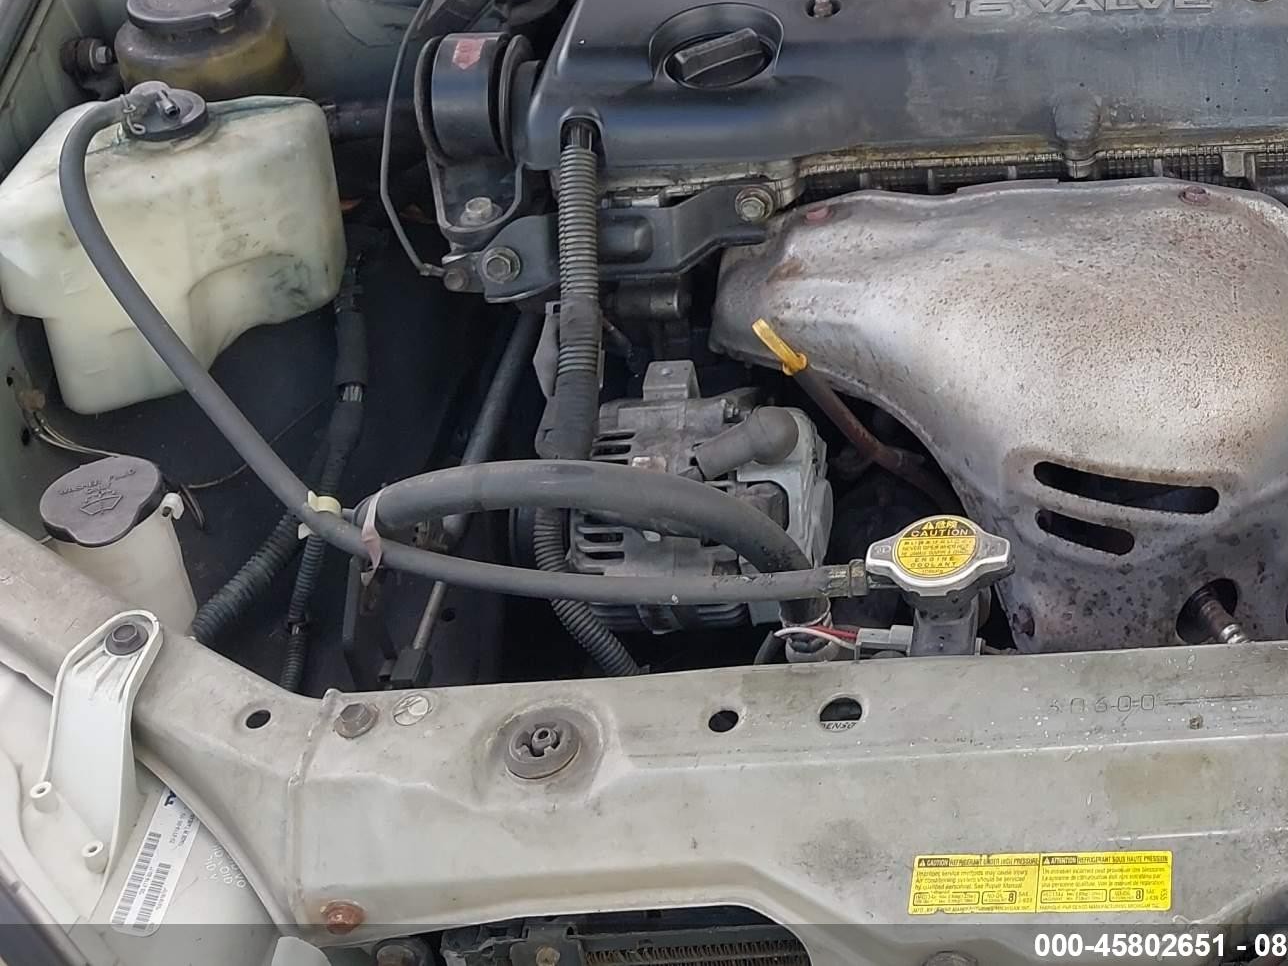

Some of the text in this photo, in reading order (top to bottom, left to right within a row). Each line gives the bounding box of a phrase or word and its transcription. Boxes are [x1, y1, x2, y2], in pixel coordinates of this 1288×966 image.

[911, 528, 969, 538] CAUTION
[926, 858, 948, 867] CAUTION
[1008, 893, 1015, 903] 8
